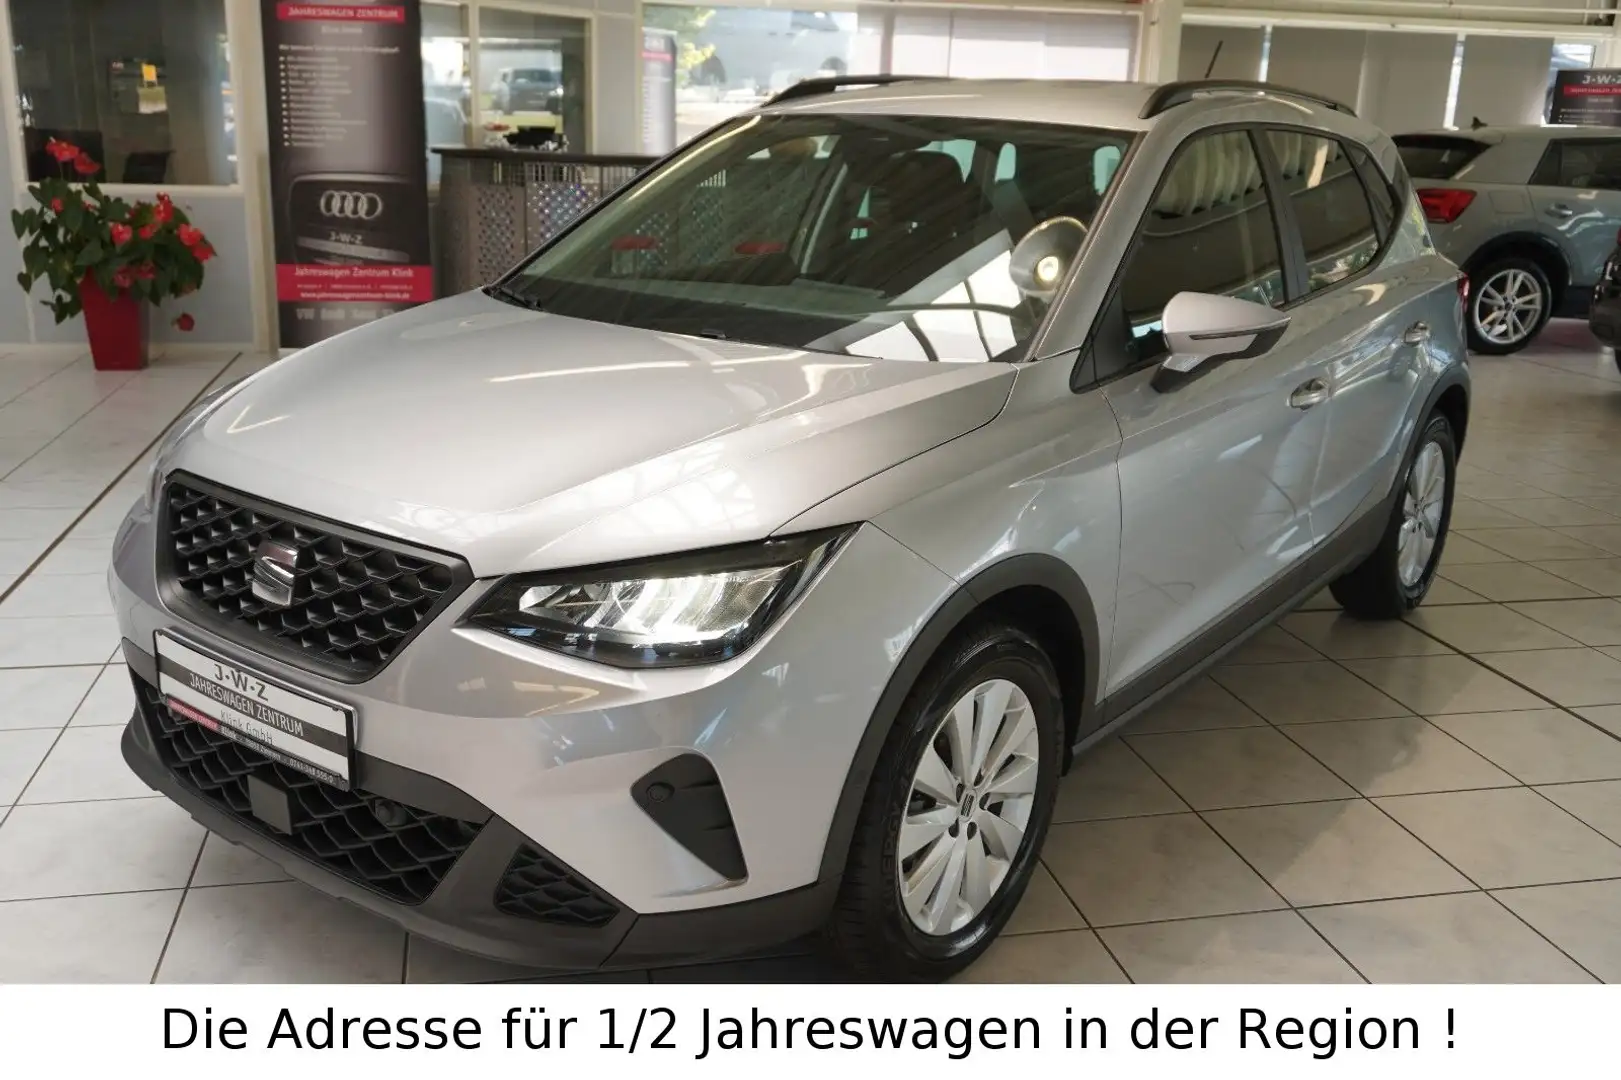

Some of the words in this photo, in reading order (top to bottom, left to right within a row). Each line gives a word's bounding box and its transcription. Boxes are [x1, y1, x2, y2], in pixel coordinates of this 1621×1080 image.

[287, 7, 354, 17] JAHRESWAGEN
[356, 8, 398, 18] ZENTRUM
[295, 267, 350, 280] Jahreswagen
[352, 267, 389, 277] Zentrum
[391, 267, 414, 277] Klink
[189, 673, 255, 716] JAHRESWAGEN
[255, 707, 304, 737] ZENTRUM
